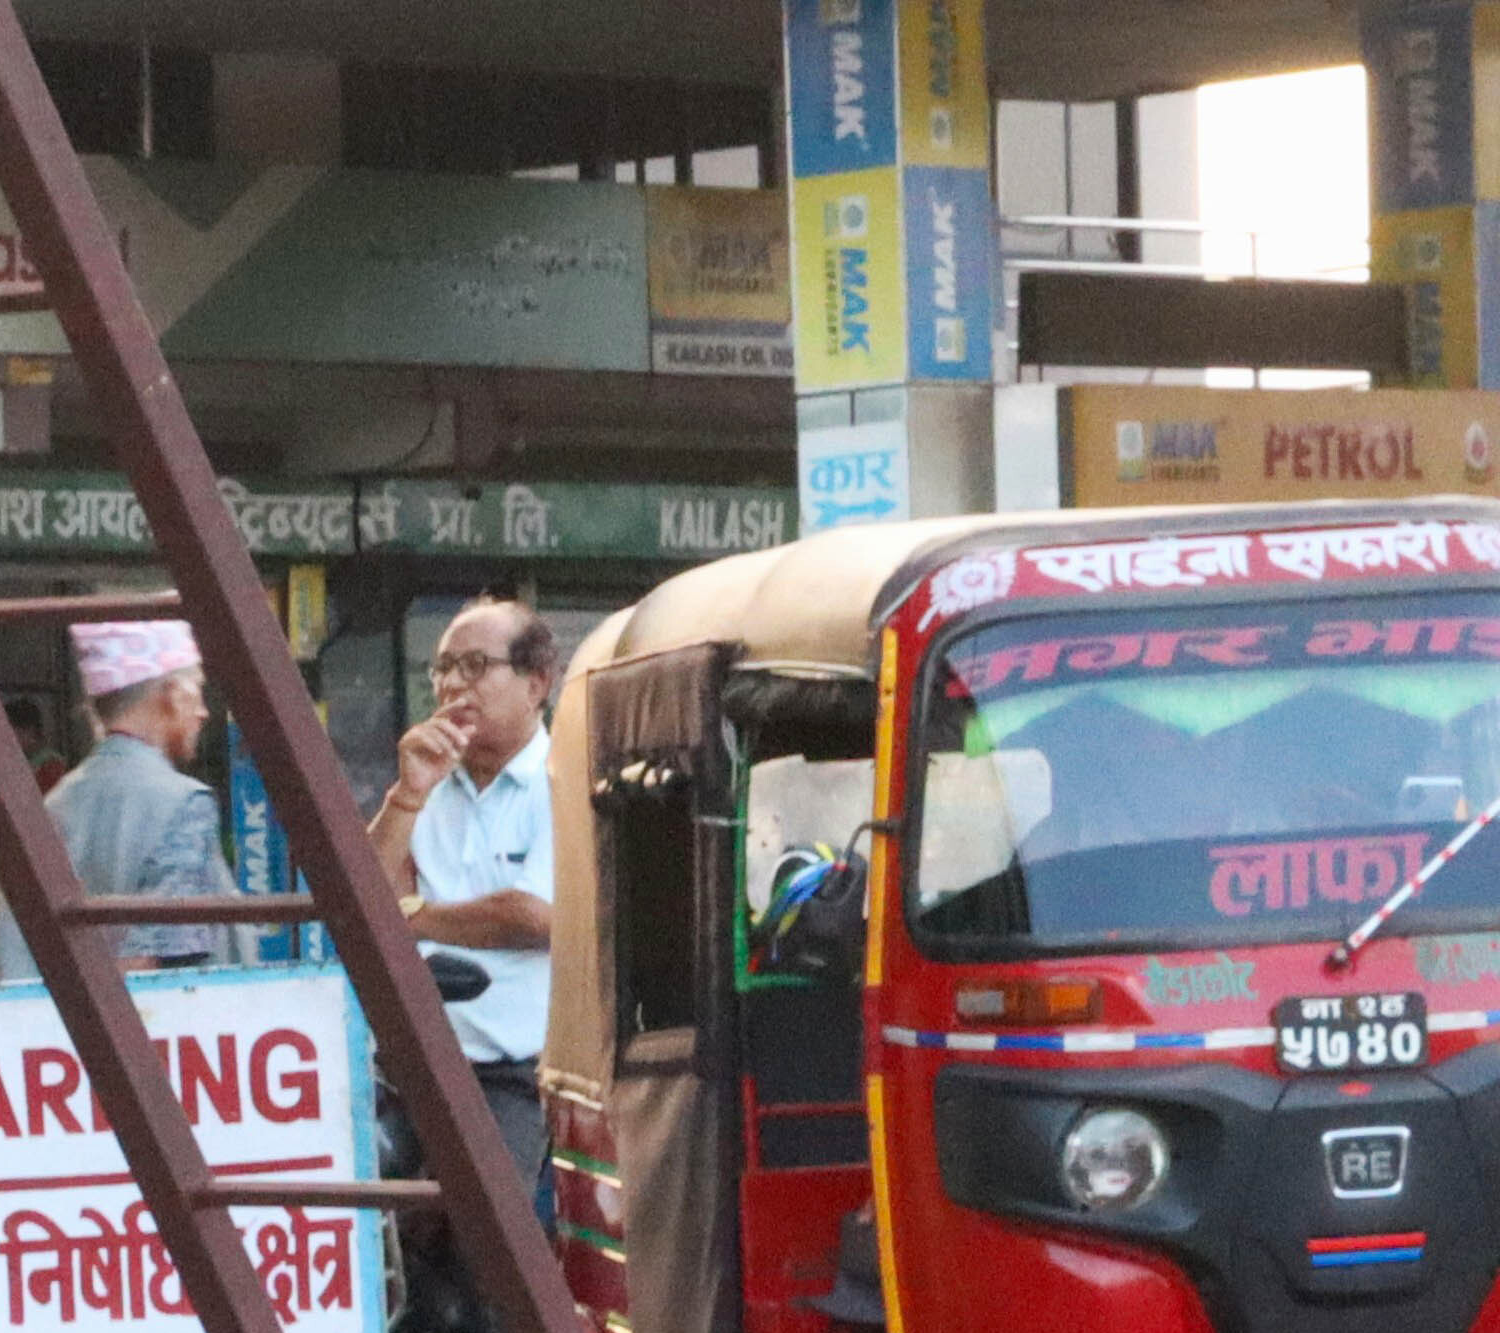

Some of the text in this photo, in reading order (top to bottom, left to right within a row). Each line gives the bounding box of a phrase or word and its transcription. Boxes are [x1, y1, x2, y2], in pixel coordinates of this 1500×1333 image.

[833, 30, 866, 142] MAK
[840, 247, 871, 354] MAK
[811, 449, 892, 494] कार
[1263, 423, 1423, 480] PETROL
[658, 500, 786, 549] KAILASH
[1208, 833, 1429, 917] लाफा
[1281, 1022, 1422, 1068] ५७४०
[1341, 1150, 1393, 1182] RE
